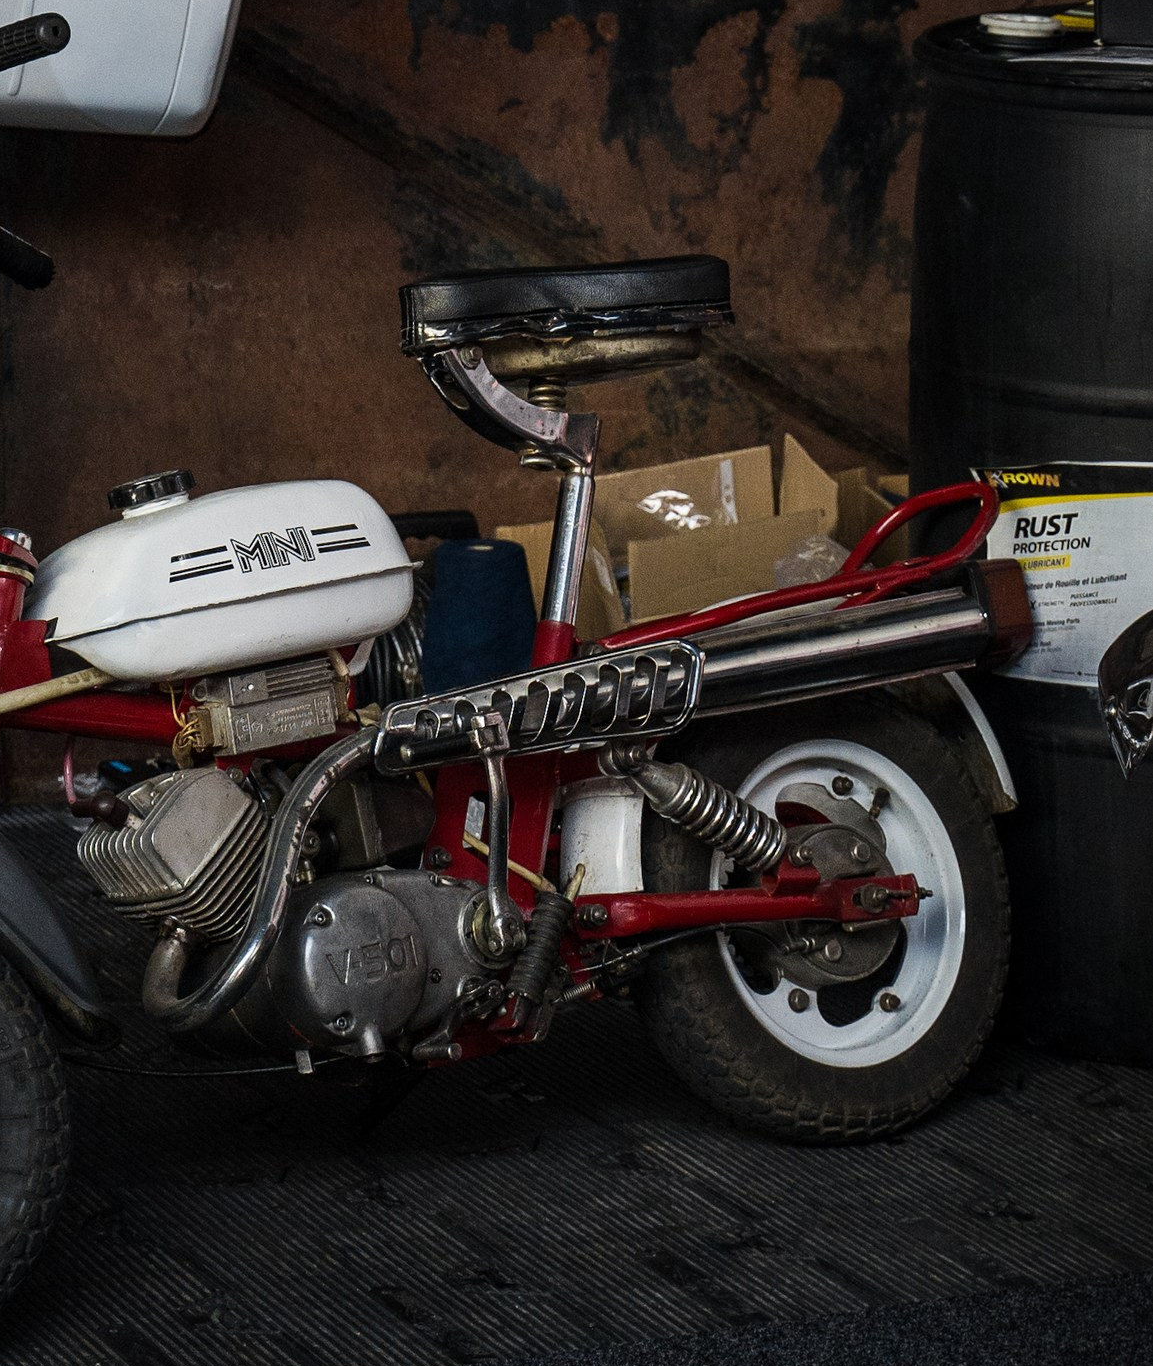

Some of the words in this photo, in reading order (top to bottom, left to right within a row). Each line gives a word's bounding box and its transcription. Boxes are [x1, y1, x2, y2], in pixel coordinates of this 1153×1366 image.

[983, 469, 1061, 489] KROWN
[1014, 513, 1079, 539] RUST
[230, 526, 316, 573] MINI
[1013, 537, 1091, 554] PROTECTION
[1022, 557, 1066, 570] LUBRICANT
[1055, 578, 1080, 588] Rouille
[1091, 573, 1128, 585] Lubrifiant
[325, 935, 419, 986] V-501
